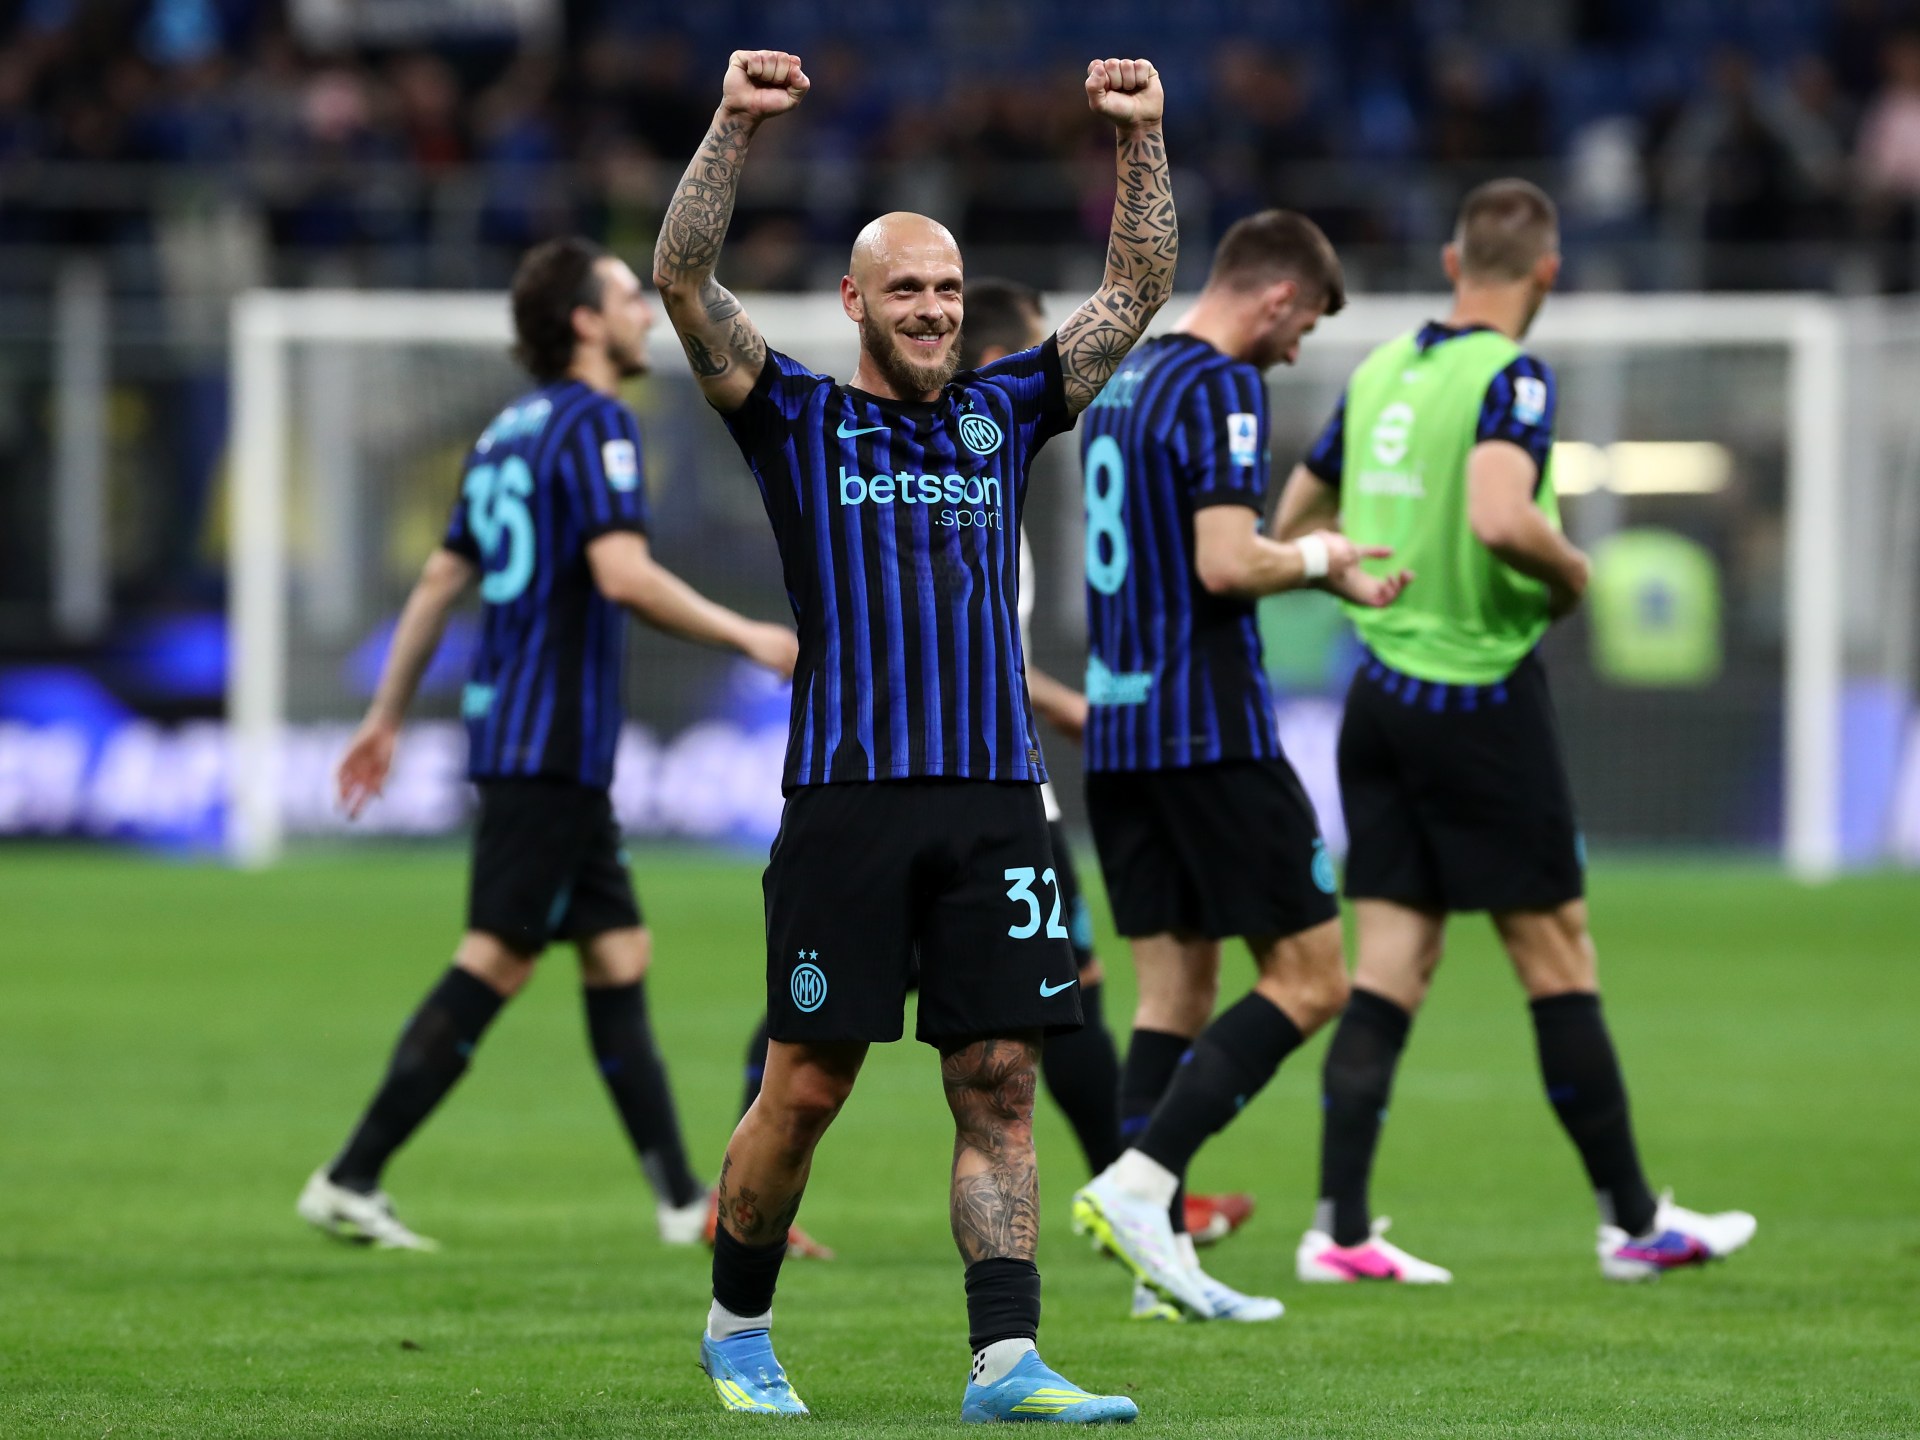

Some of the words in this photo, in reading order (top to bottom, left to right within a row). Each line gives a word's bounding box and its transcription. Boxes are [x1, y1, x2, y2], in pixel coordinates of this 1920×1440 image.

[1113, 159, 1152, 244] Nicholas
[839, 467, 1001, 507] betsson
[935, 509, 1002, 531] .sport
[1085, 435, 1128, 595] 8
[1004, 866, 1069, 940] 32
